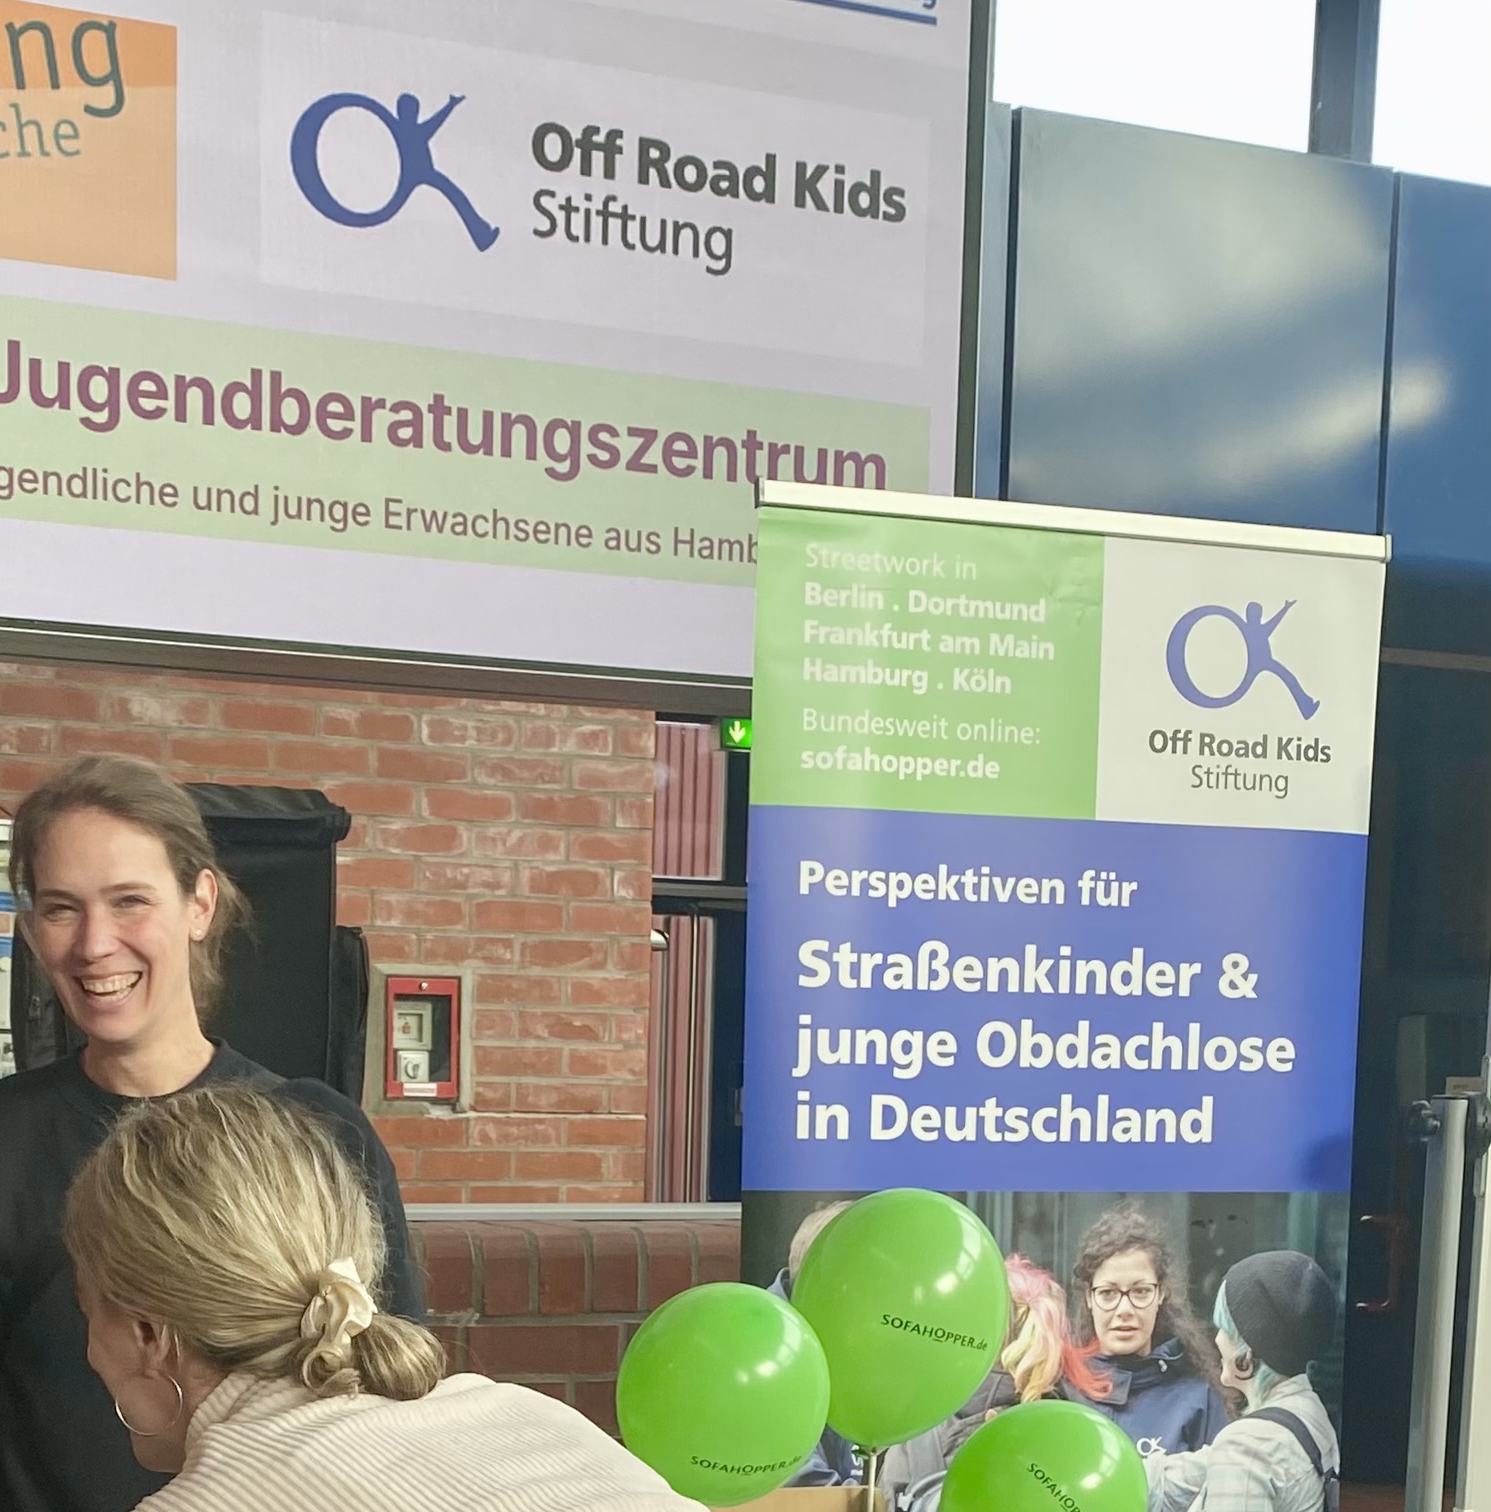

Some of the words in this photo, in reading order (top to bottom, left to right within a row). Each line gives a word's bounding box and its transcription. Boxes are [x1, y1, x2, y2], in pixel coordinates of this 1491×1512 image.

[531, 122, 623, 179] Off
[637, 137, 776, 203] Road
[793, 160, 907, 223] Kids
[532, 189, 733, 276] Stiftung
[193, 482, 260, 518] und
[270, 486, 372, 534] junge
[384, 497, 593, 551] Erwachsene
[603, 522, 662, 557] aus
[805, 543, 945, 578] Streetwork
[954, 555, 977, 580] in
[804, 583, 884, 611] Berlin
[909, 590, 1046, 623] Dortmund
[804, 620, 930, 652] Frankfurt
[939, 631, 980, 655] am
[989, 634, 1055, 661] Main
[802, 659, 928, 695] Hamburg
[953, 666, 1011, 695] Köln
[802, 709, 948, 741] Bundesweit
[956, 715, 1041, 746] online:
[1148, 728, 1192, 755] Off
[1198, 733, 1268, 760] Road
[1276, 736, 1332, 763] Kids
[800, 746, 1000, 782] sofahopper.de
[1190, 765, 1289, 799] Stiftung
[798, 860, 1064, 907] Perspektiven
[1077, 869, 1137, 907] für
[796, 939, 1202, 998] Straßenkinder
[1217, 952, 1258, 998] &
[792, 1015, 958, 1079] junge
[975, 1019, 1296, 1072] Obdachlose
[795, 1090, 850, 1140] in
[869, 1094, 1213, 1143] Deutschland
[880, 1314, 988, 1351] SOFAHOPPER.de
